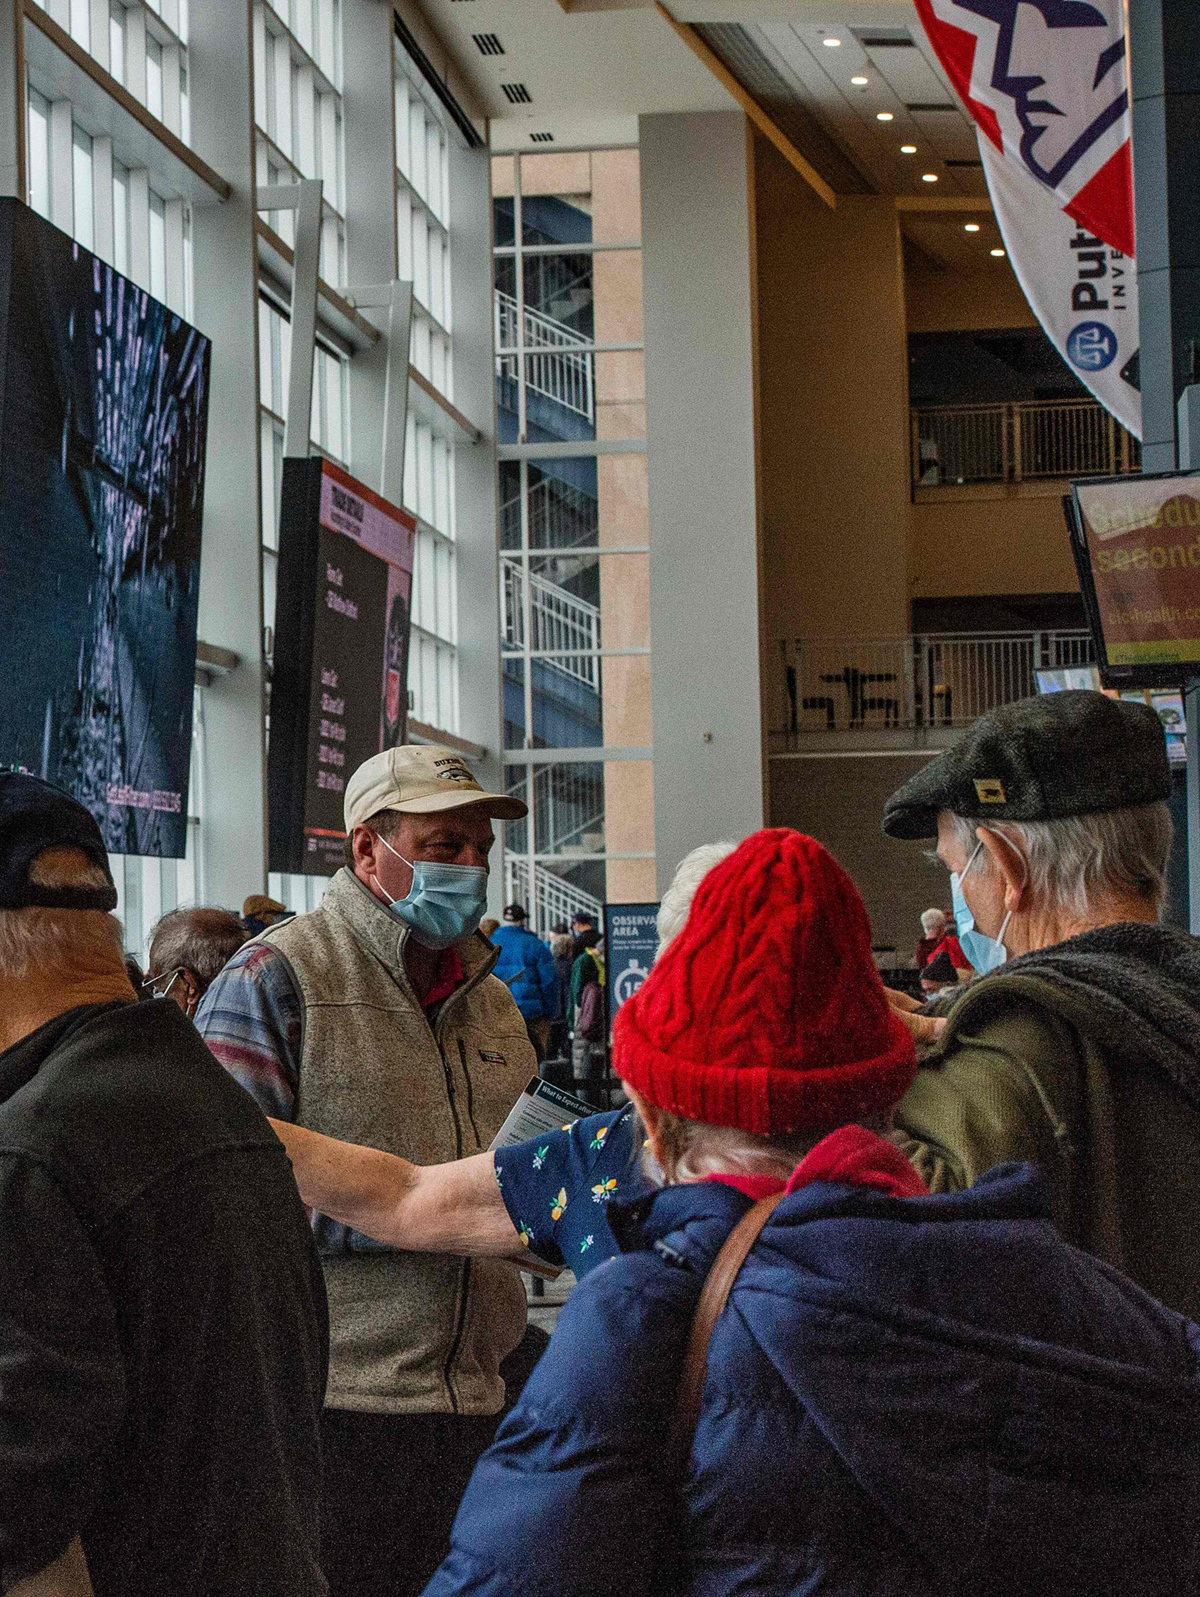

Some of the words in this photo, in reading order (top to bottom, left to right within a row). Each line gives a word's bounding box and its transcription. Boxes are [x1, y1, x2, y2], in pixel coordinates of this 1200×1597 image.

[613, 927, 639, 937] AREA
[542, 1085, 556, 1097] What
[556, 1093, 563, 1101] to
[562, 1096, 579, 1109] Expect
[579, 1105, 592, 1115] after
